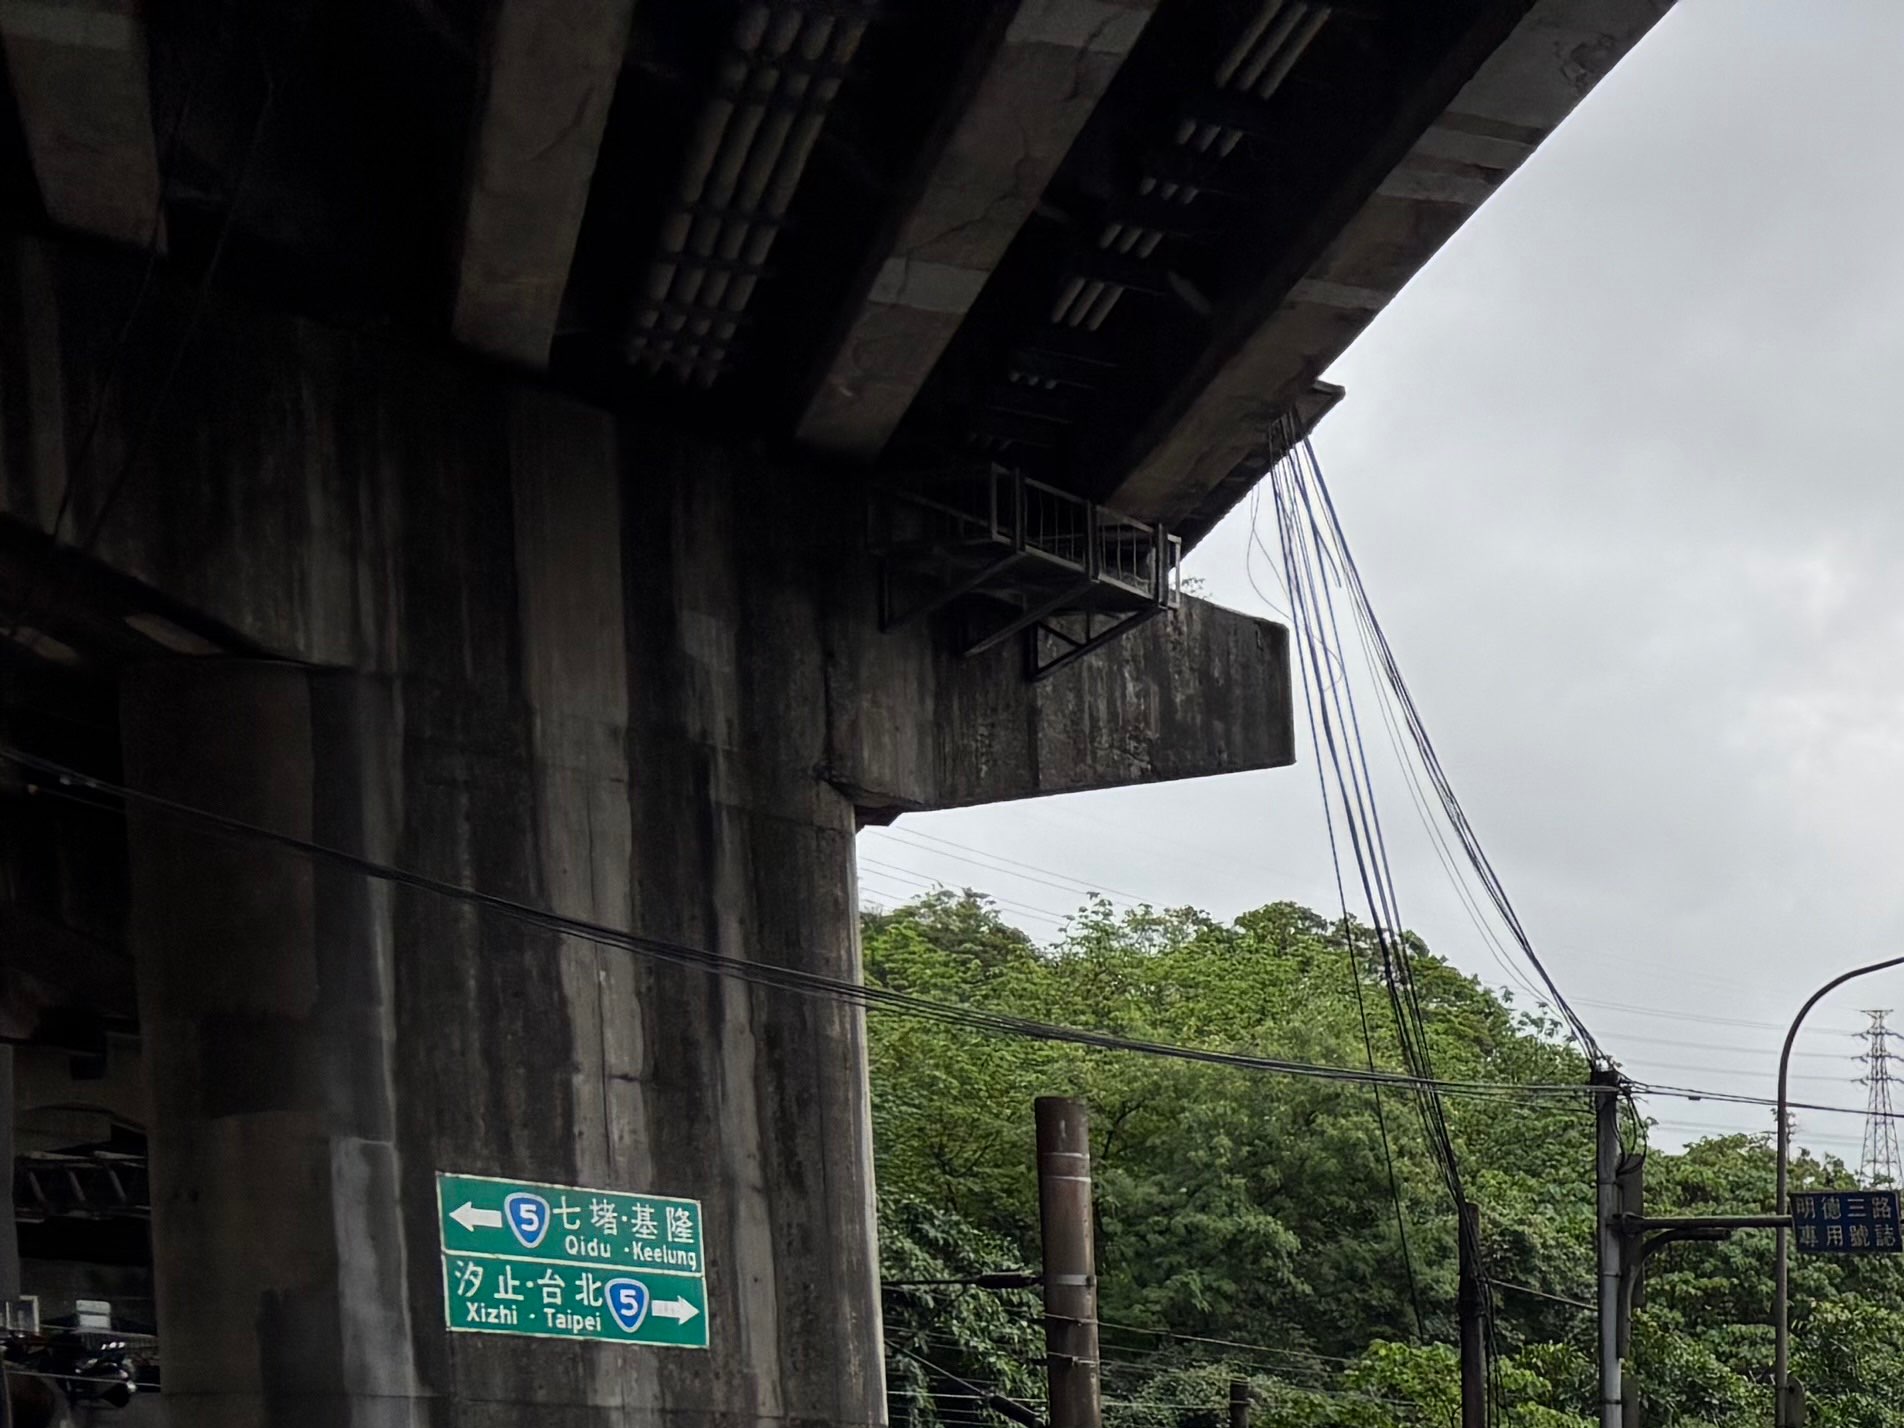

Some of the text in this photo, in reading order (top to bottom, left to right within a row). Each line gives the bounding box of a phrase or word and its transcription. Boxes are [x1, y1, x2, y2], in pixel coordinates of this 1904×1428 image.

[519, 1204, 539, 1232] 5
[1796, 1195, 1892, 1219] 明德三路
[565, 1234, 611, 1259] Qidu
[1797, 1223, 1896, 1248] 專用號誌
[619, 1289, 639, 1317] 5
[466, 1301, 602, 1335] Xizhi Taipei
